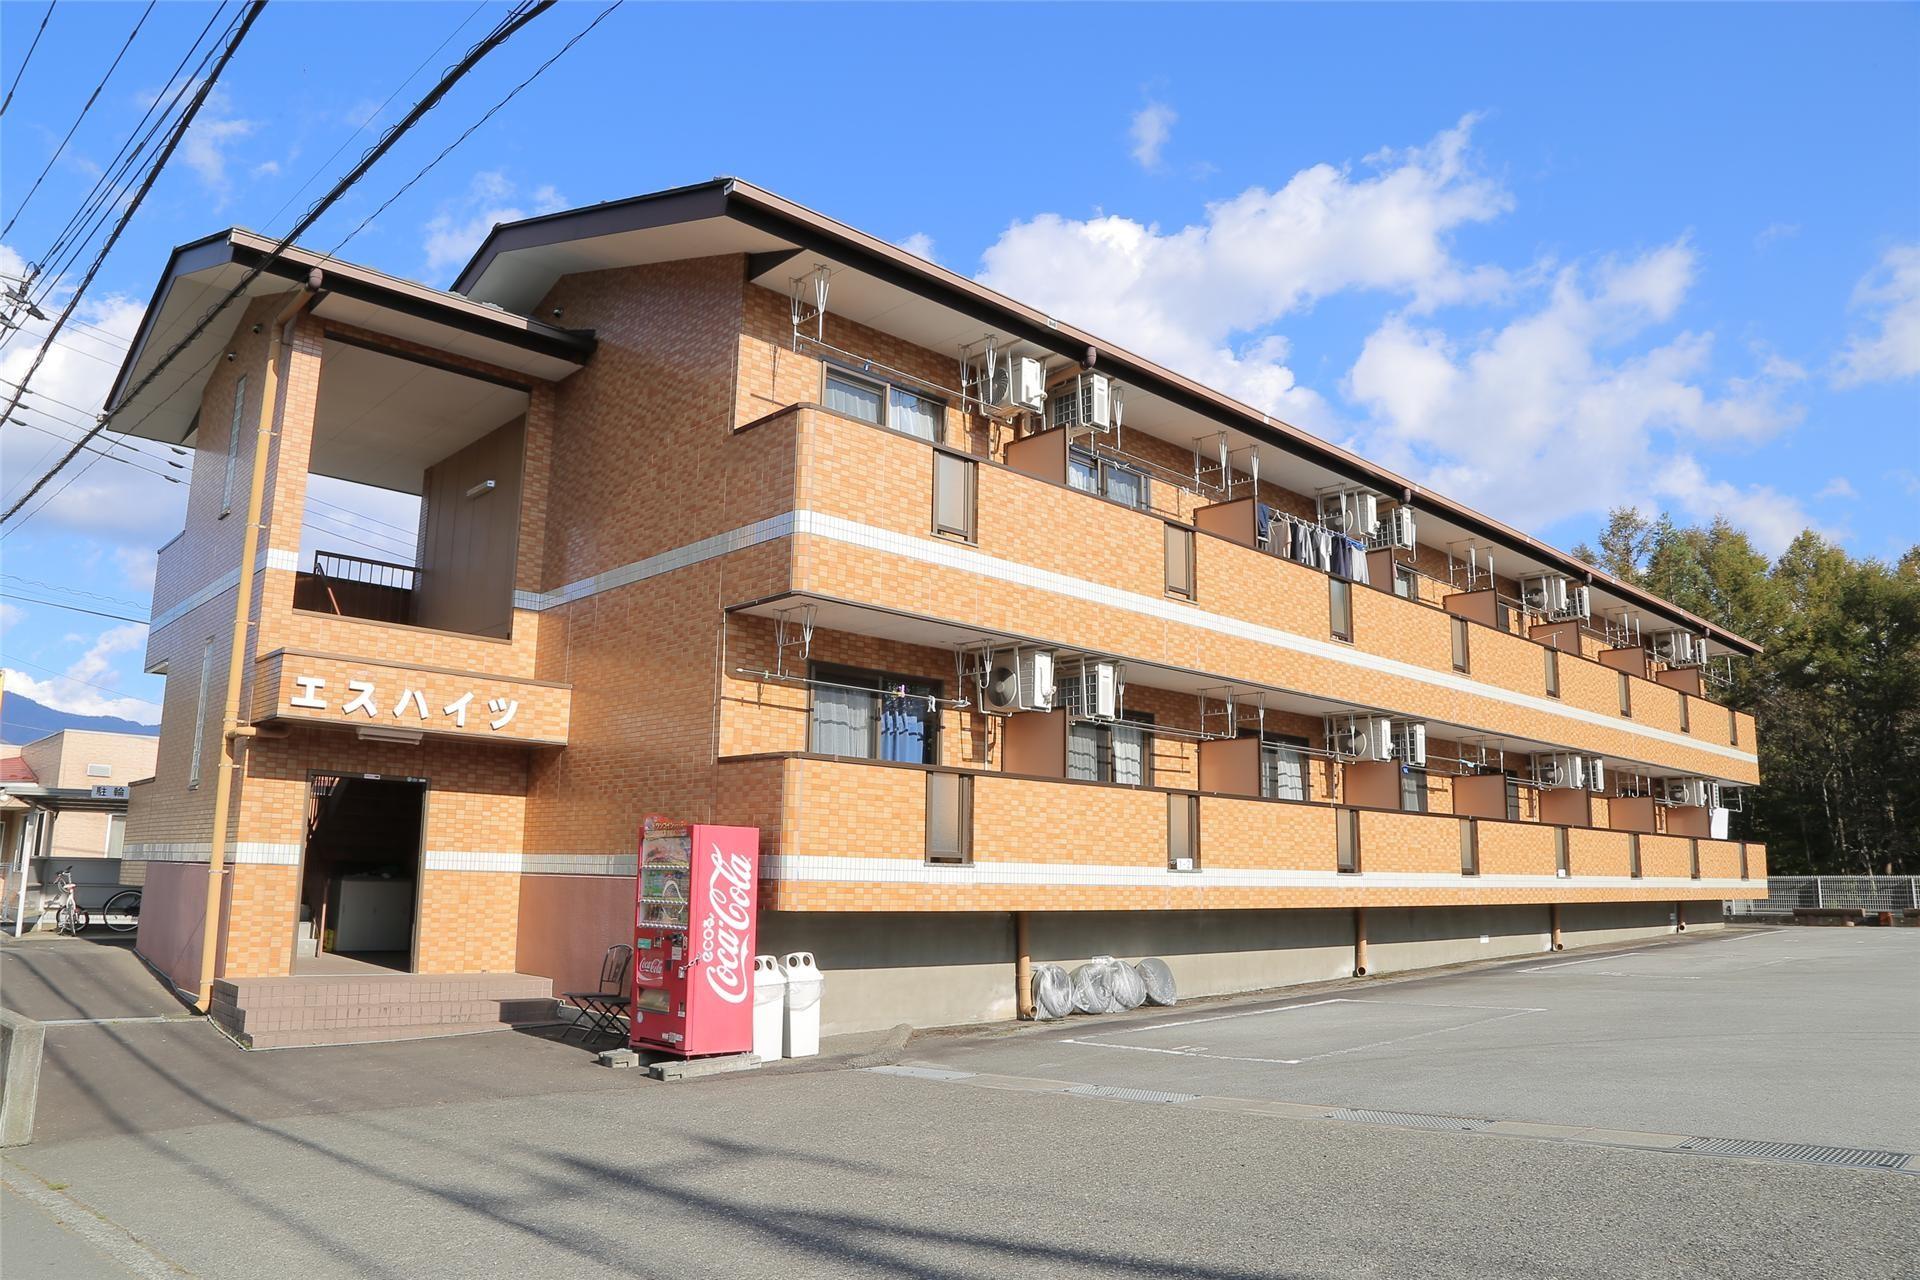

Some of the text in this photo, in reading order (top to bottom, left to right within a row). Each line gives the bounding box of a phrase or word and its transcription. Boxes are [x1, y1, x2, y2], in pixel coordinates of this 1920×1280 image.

[290, 675, 519, 730] エスハイツ
[706, 847, 751, 1003] Coca-Cola
